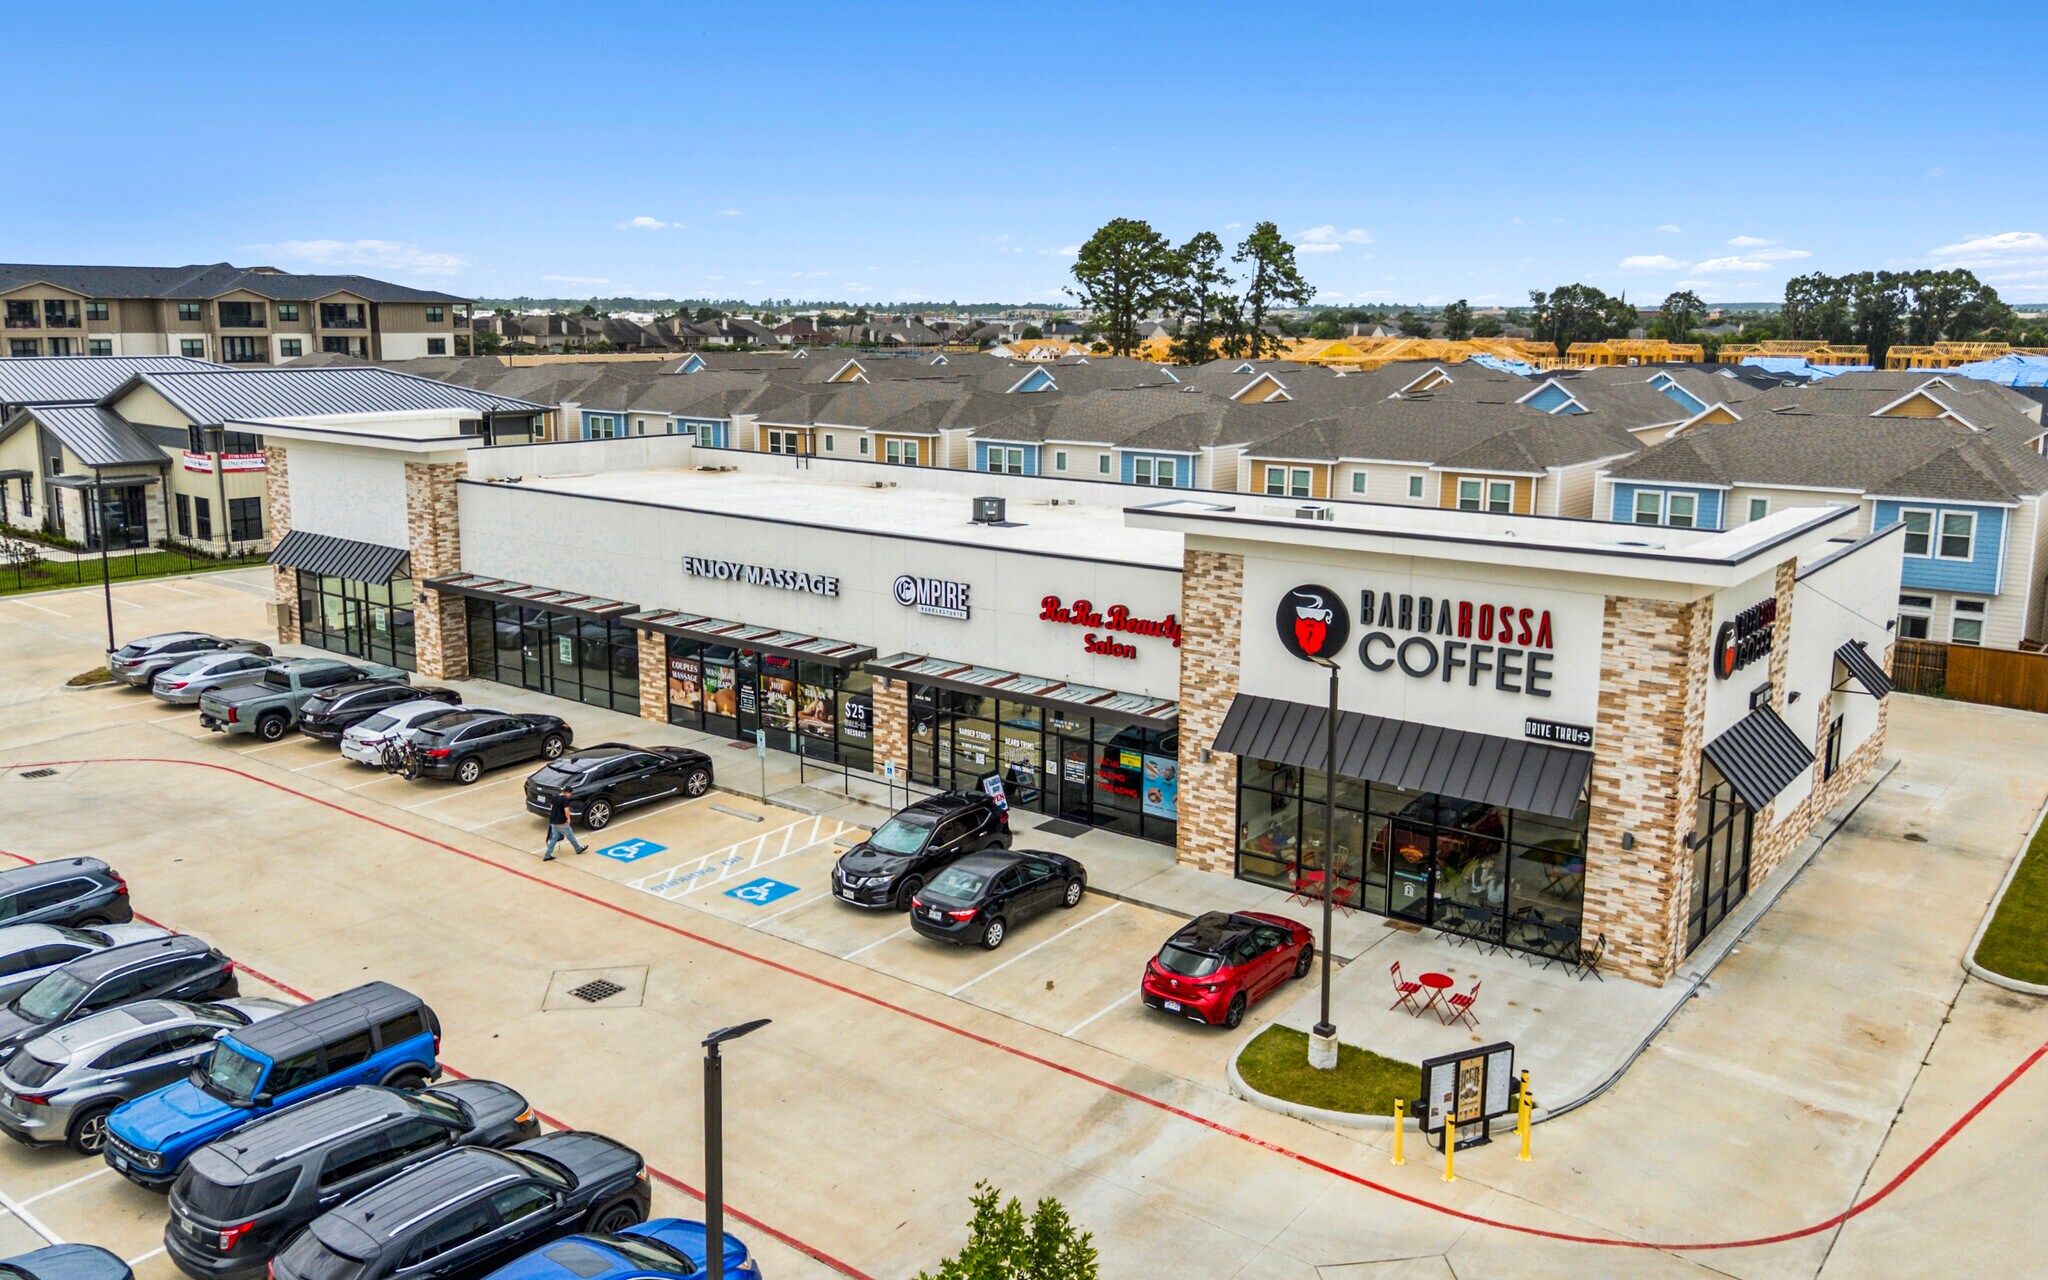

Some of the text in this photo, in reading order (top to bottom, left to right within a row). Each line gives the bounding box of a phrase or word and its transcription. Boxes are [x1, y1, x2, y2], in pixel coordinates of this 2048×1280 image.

[682, 556, 840, 597] ENJOY MASSAGE
[895, 576, 970, 611] EMPIRE
[1104, 604, 1181, 648] Beauty
[1361, 589, 1554, 649] BARBAROSSA
[1083, 633, 1137, 660] Salon
[671, 660, 699, 673] COUPLES
[1358, 631, 1554, 698] COFFEE
[671, 670, 699, 683] MASSAGE
[707, 677, 733, 690] THERAPY
[770, 681, 785, 691] HOT
[844, 701, 865, 720] $25
[844, 727, 867, 739] TUESDAYS
[1525, 721, 1578, 742] DRIVE THRU
[1096, 756, 1121, 769] FACIAL
[992, 793, 1005, 803] PEN
[1096, 781, 1139, 799] THREADING
